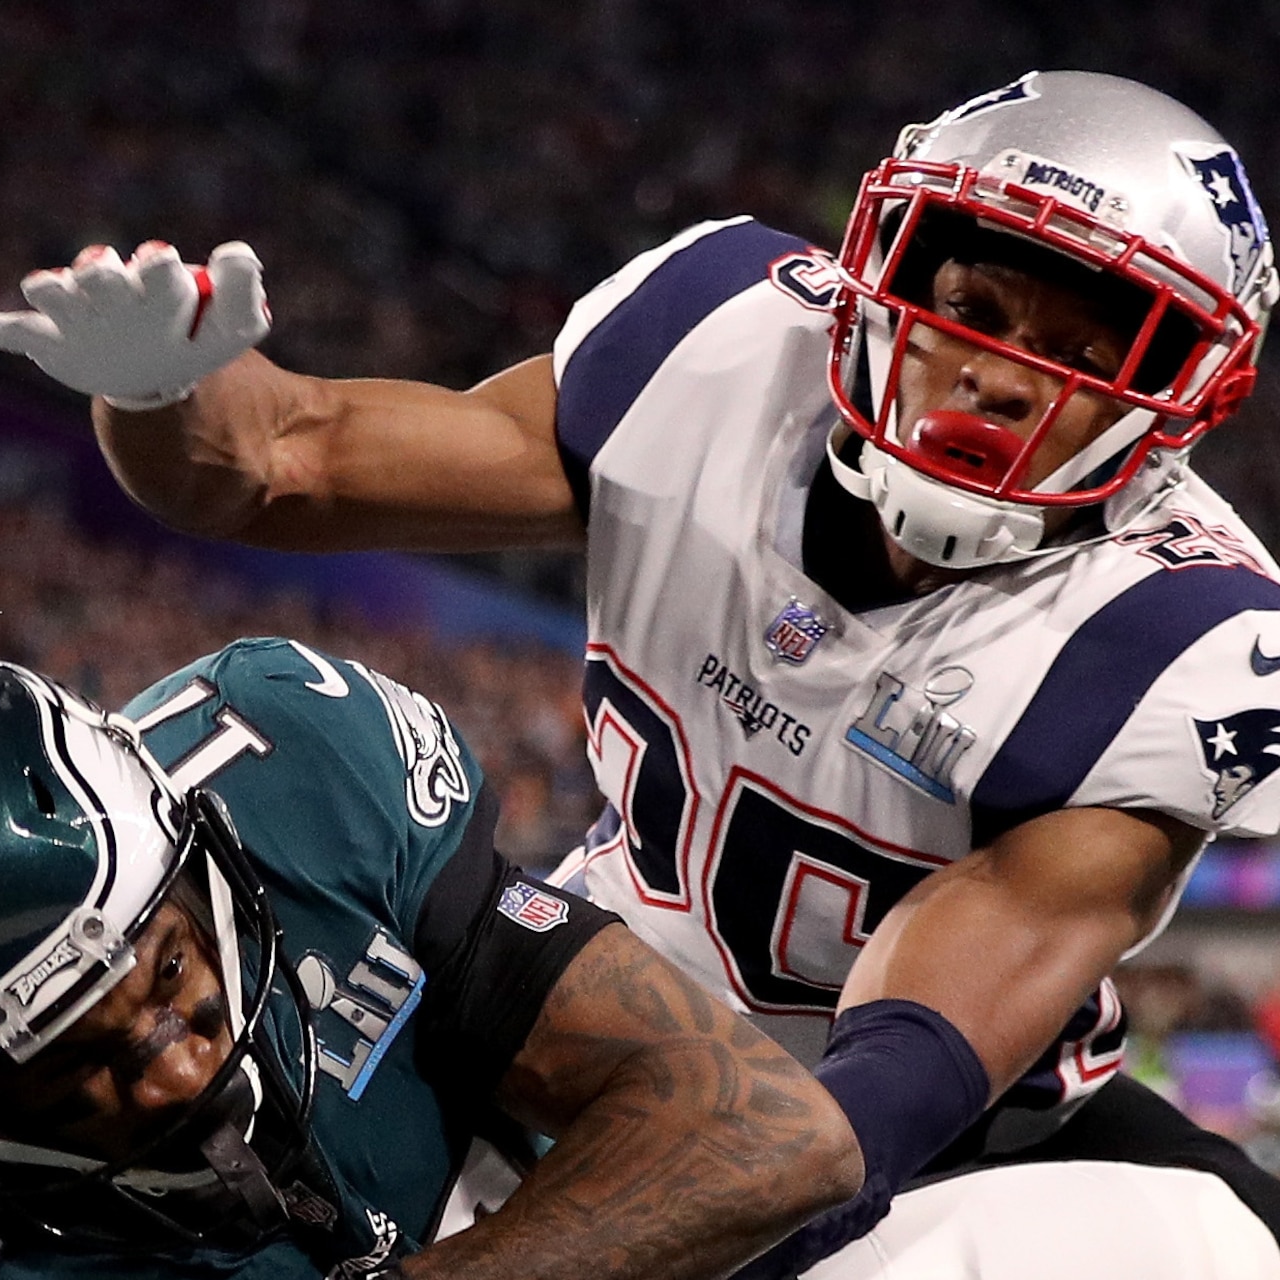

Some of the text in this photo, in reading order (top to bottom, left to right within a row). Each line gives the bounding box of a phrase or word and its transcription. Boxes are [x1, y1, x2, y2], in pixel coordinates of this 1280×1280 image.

[1021, 161, 1105, 212] PATRIOTS
[772, 621, 812, 658] NFL
[697, 653, 811, 756] PATRIOTS
[518, 896, 561, 926] NFL
[5, 934, 82, 1006] EAGLES
